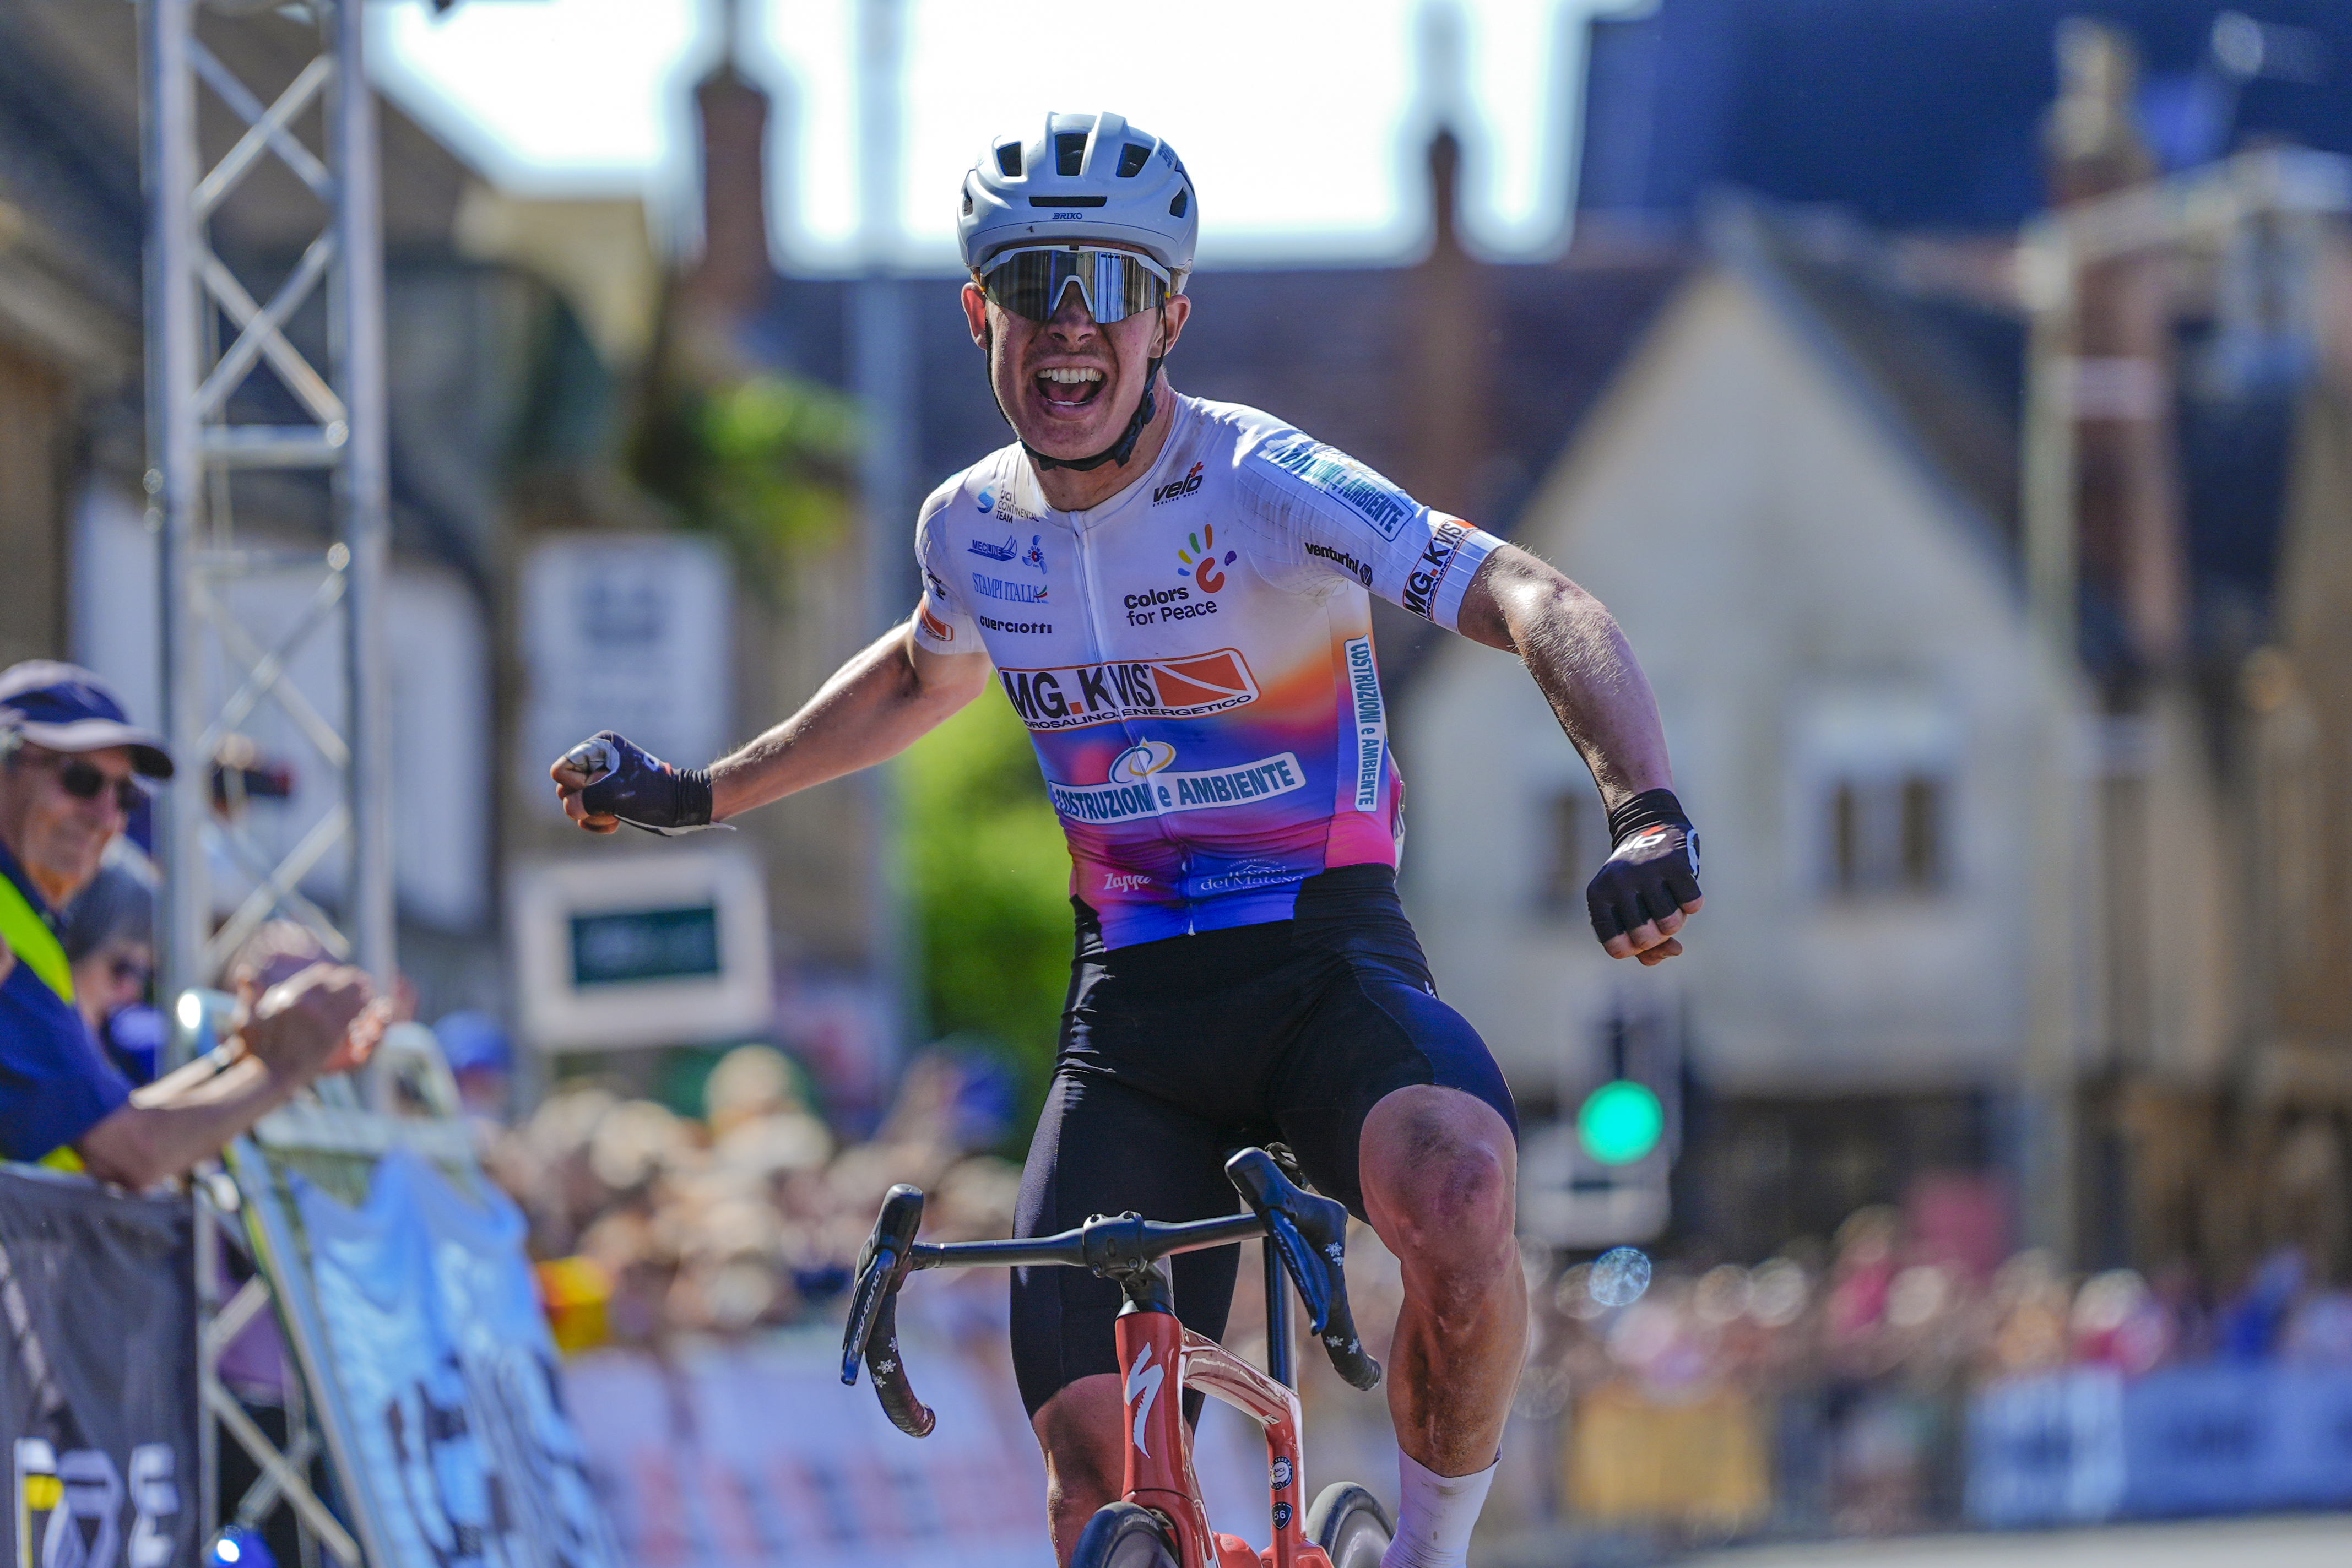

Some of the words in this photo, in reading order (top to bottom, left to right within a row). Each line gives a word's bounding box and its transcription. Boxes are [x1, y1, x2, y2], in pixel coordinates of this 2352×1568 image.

[1000, 489, 1012, 502] UCI
[1153, 473, 1203, 502] velo
[996, 510, 1013, 523] TEAM
[998, 500, 1039, 522] CONTINENTAL
[1337, 478, 1405, 533] AMBIENTE
[1304, 542, 1359, 575] venturini
[1124, 587, 1189, 609] Colors
[1126, 610, 1155, 626] for
[1160, 601, 1218, 622] Peace
[1350, 642, 1381, 724] COSTRUZIONI
[1361, 727, 1376, 735] e
[1157, 786, 1173, 807] e
[1177, 759, 1296, 805] AMBIENTE
[1358, 739, 1380, 806] AMBIENTE
[1200, 878, 1229, 891] del
[1274, 1510, 1286, 1520] 56
